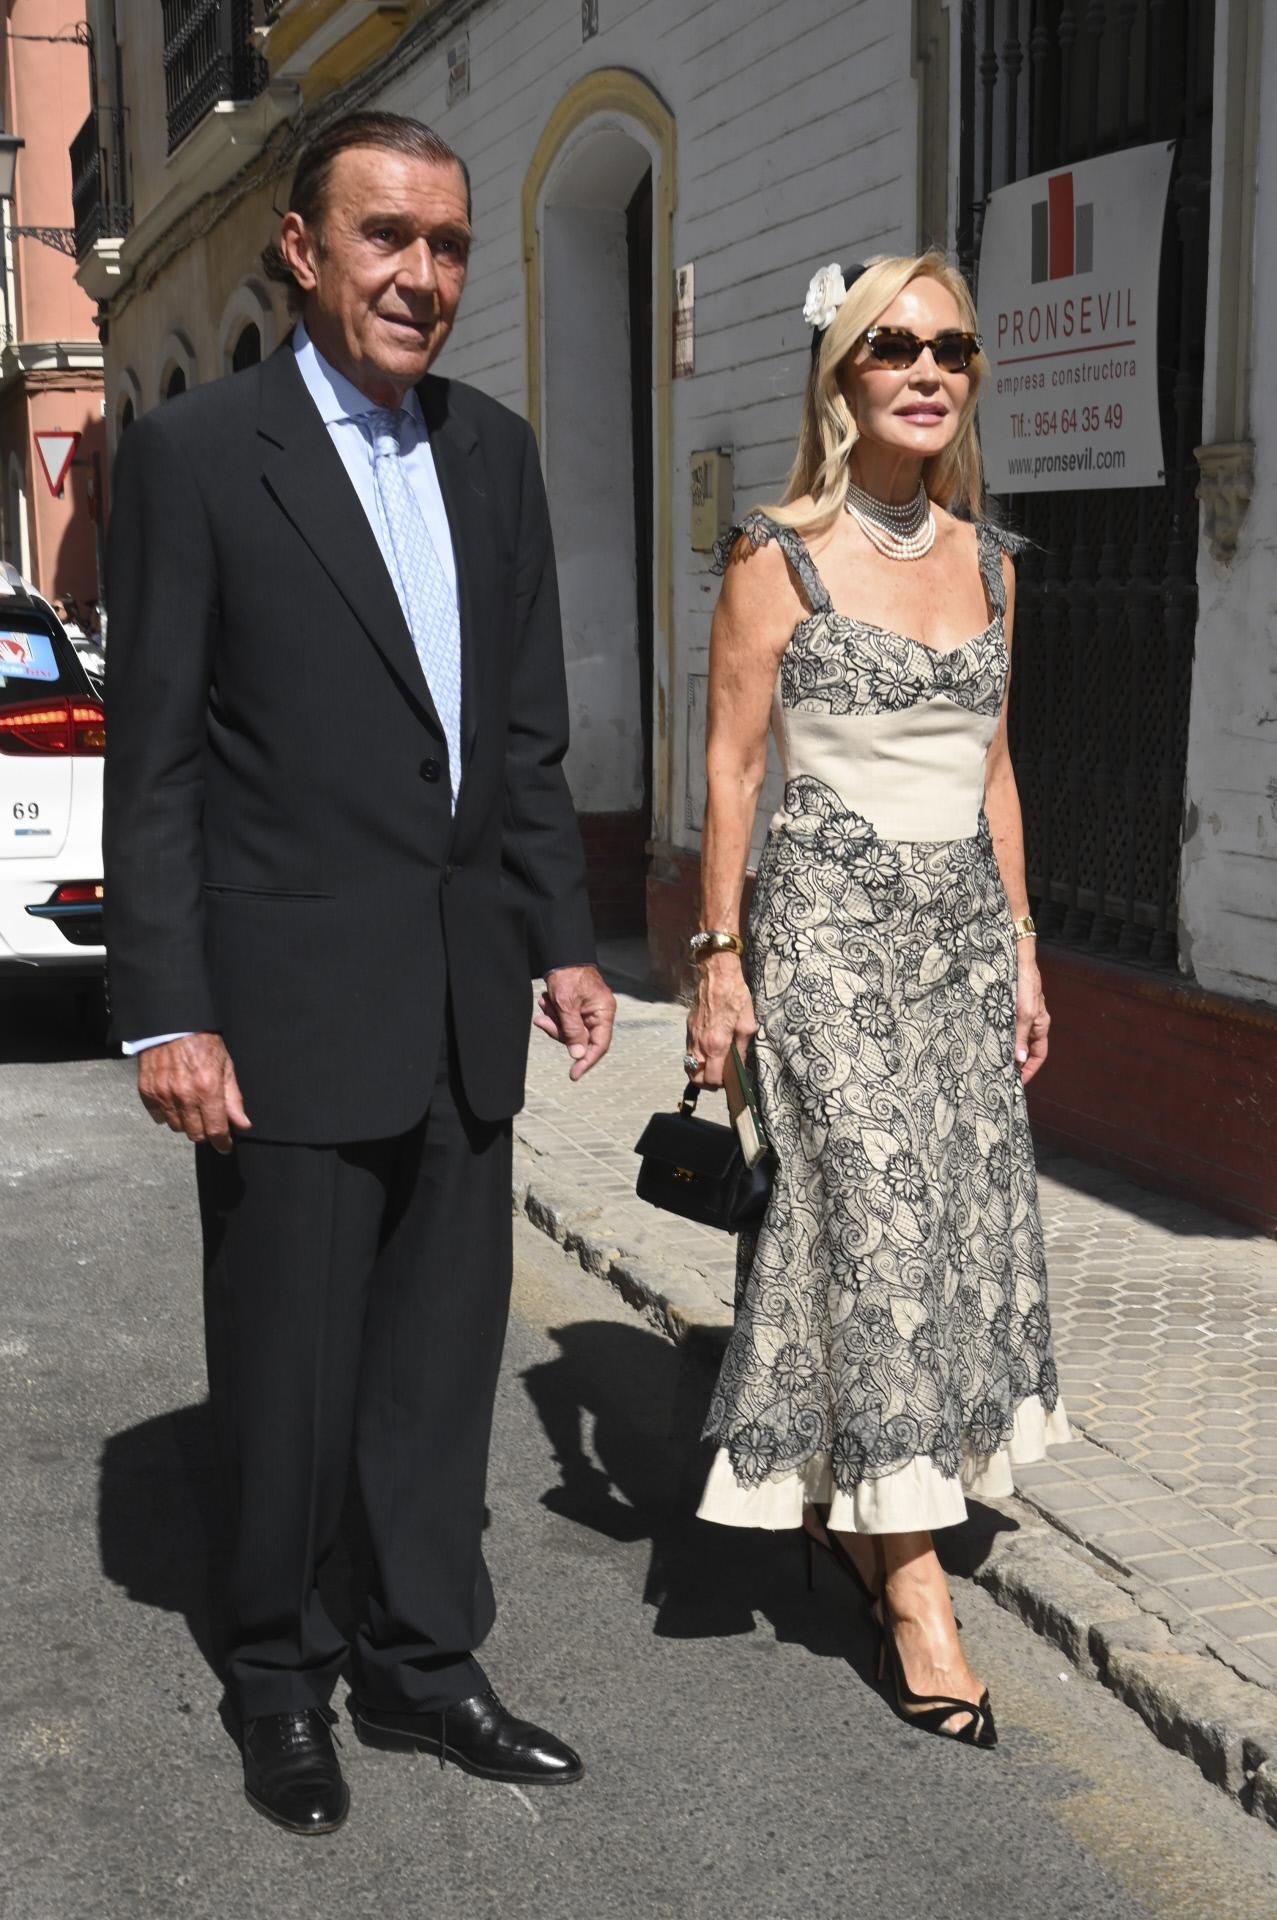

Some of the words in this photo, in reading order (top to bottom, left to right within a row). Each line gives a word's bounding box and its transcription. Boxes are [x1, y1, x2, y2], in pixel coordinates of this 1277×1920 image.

[998, 288, 1136, 349] PRONSEVIL
[997, 372, 1045, 397] empresa
[1052, 359, 1136, 386] constructora
[1034, 411, 1057, 437] 954
[1061, 408, 1077, 434] 64
[1081, 406, 1100, 432] 35
[1104, 403, 1123, 430] 49
[1008, 446, 1125, 479] www.pronsevil.com
[13, 802, 39, 820] 69
